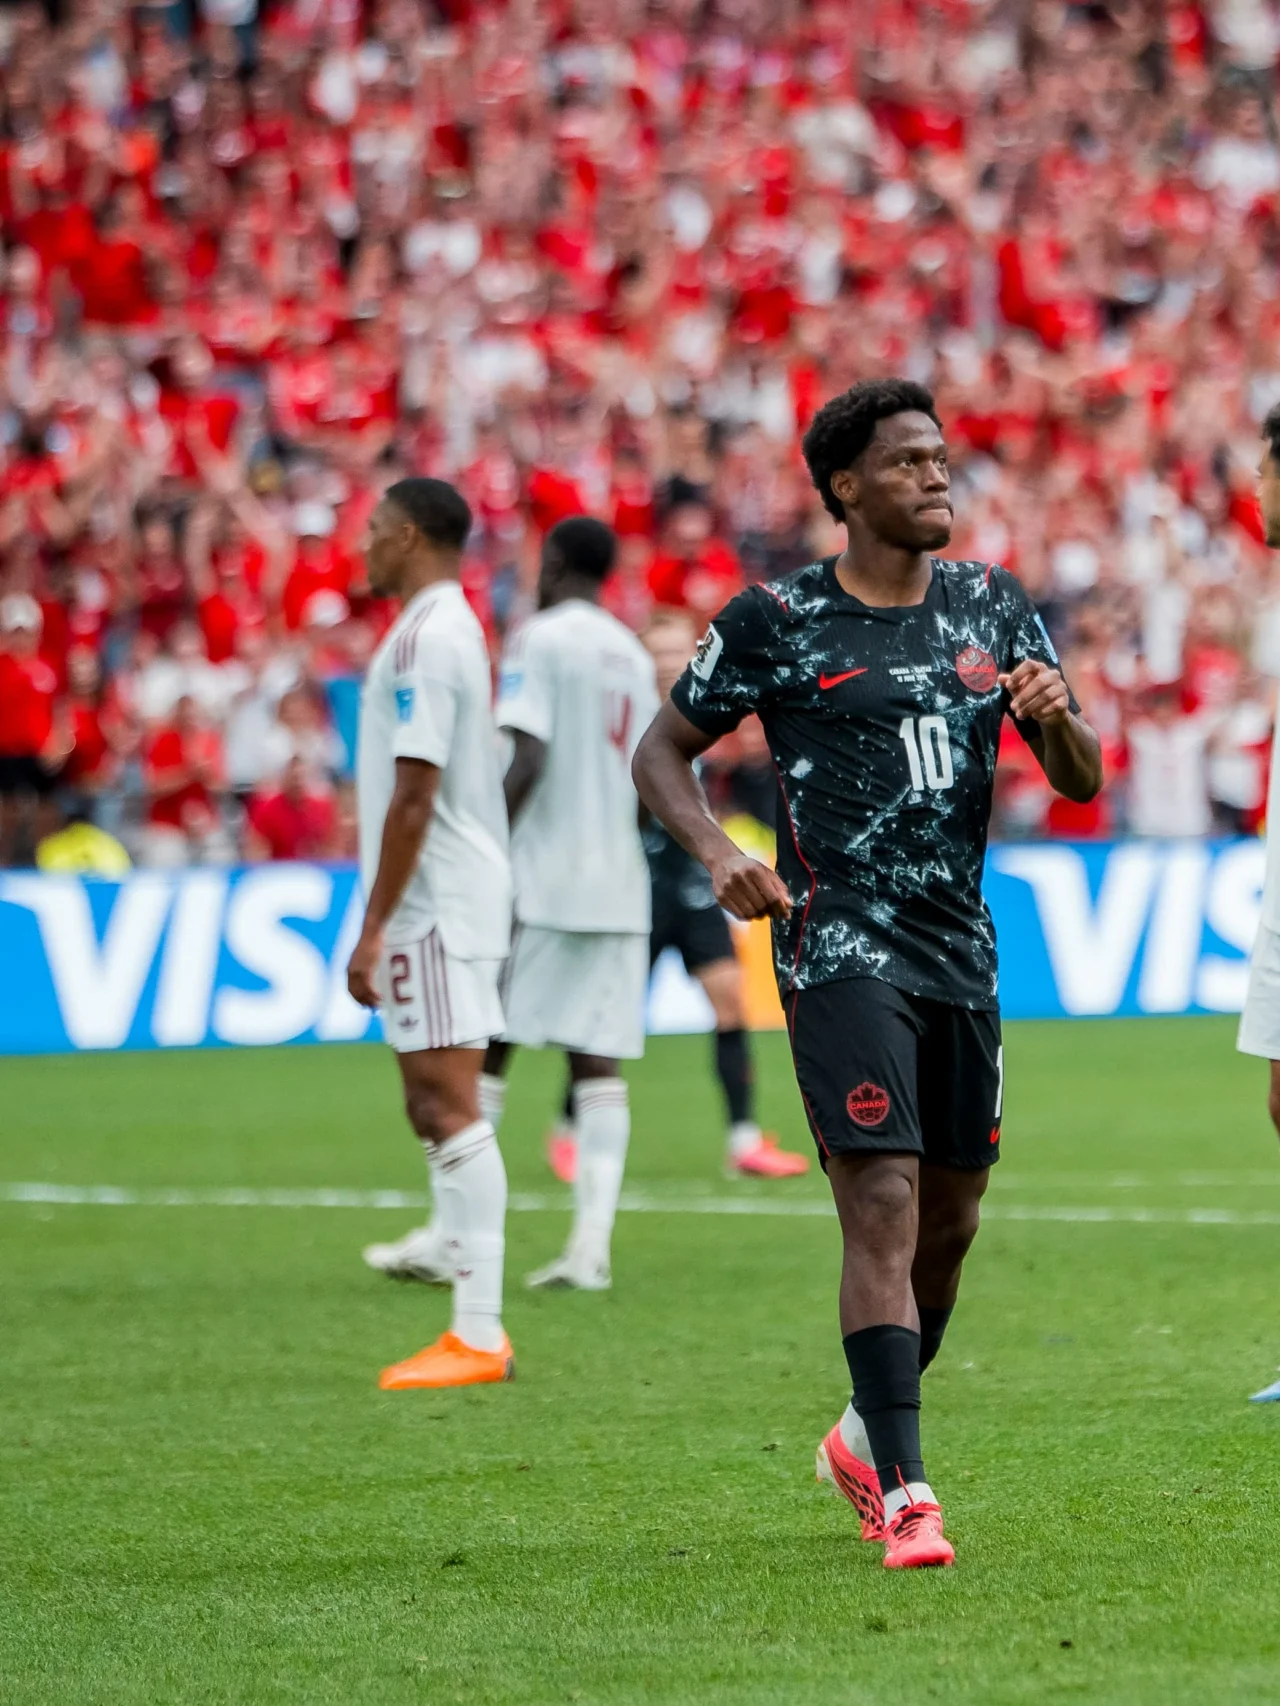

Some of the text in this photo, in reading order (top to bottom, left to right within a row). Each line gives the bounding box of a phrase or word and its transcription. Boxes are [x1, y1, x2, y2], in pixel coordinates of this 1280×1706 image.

[899, 715, 954, 791] 10
[992, 838, 1266, 1015] VIS
[390, 954, 414, 1006] 2
[850, 1101, 887, 1110] CANADA
